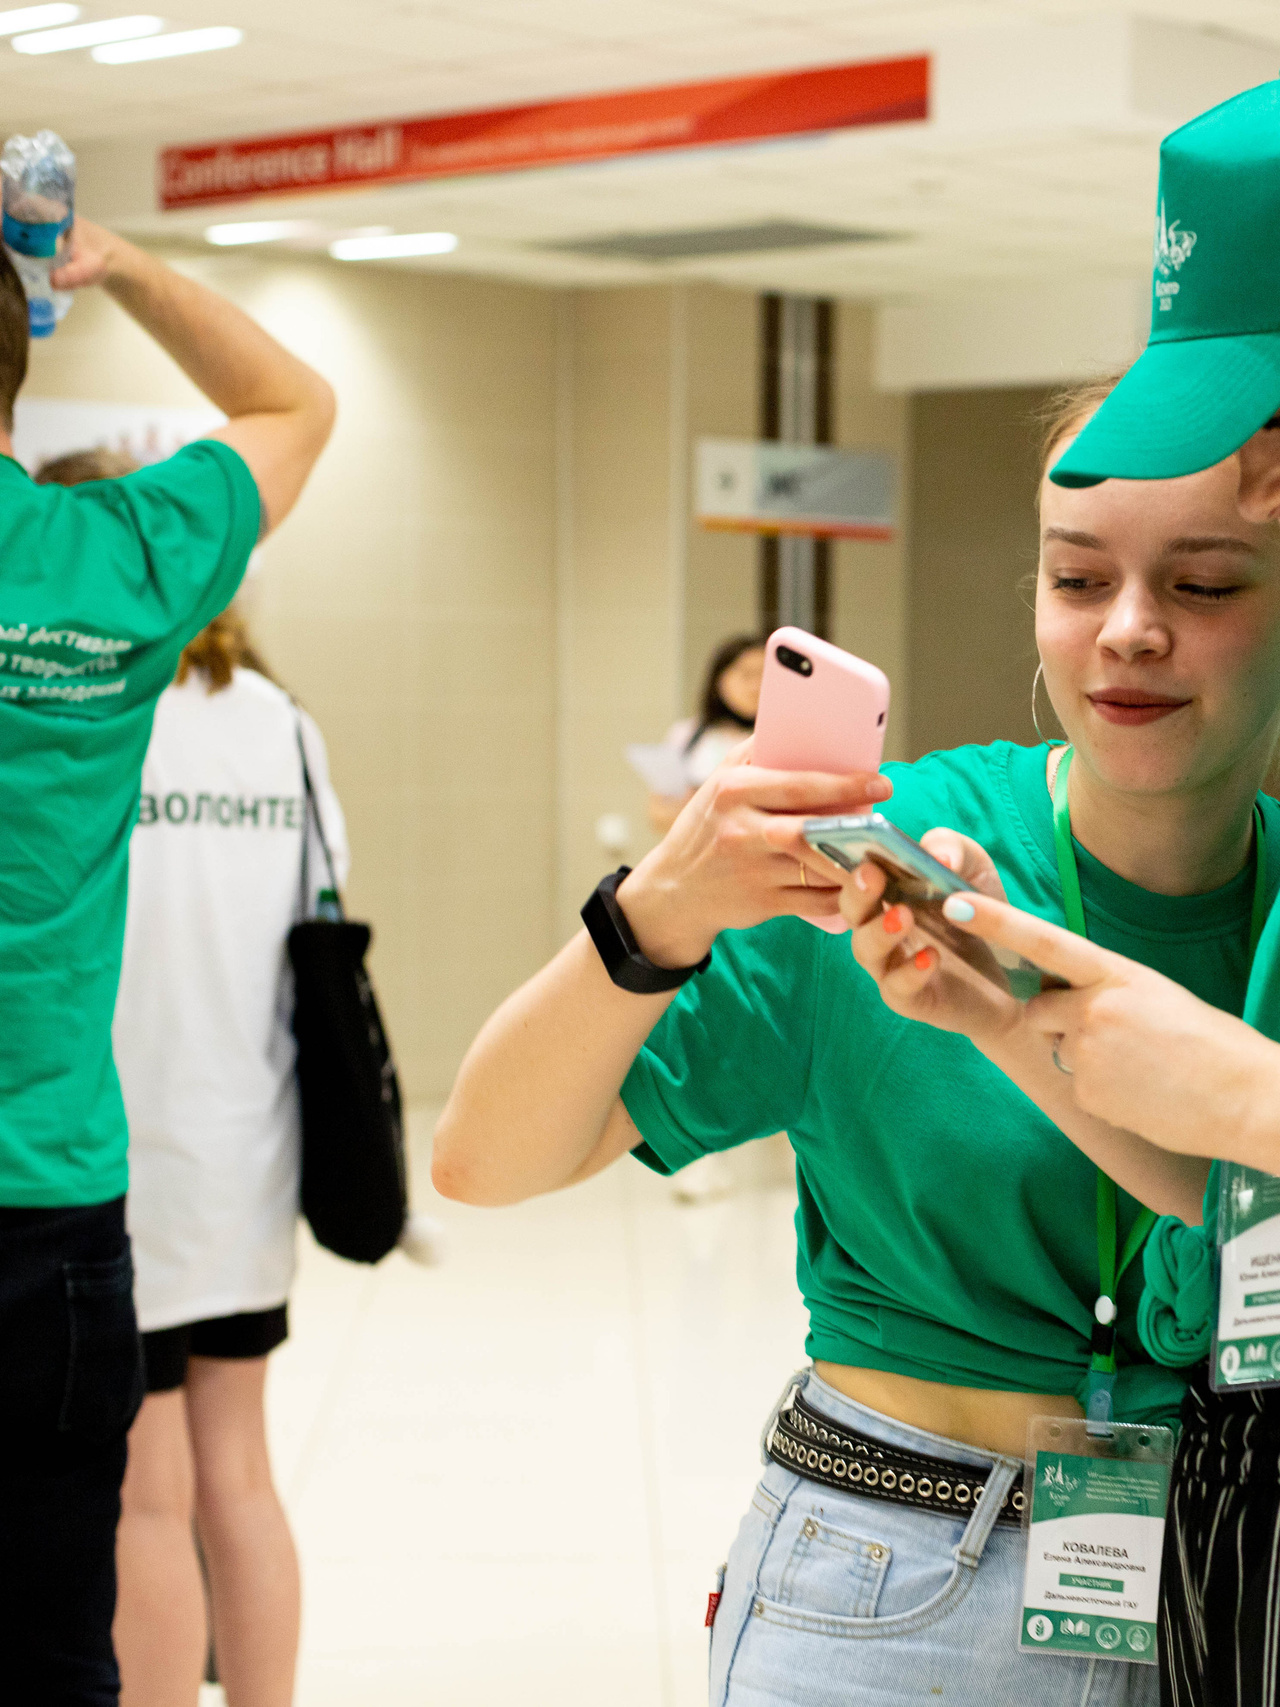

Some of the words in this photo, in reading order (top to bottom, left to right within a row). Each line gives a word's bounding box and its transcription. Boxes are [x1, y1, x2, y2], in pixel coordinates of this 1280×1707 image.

[333, 123, 399, 176] Hall
[1062, 1540, 1129, 1559] КОВАЛЕВА
[1043, 1551, 1072, 1563] Елена
[1074, 1556, 1146, 1573] Александровна
[1043, 1590, 1121, 1607] Дальневосточный
